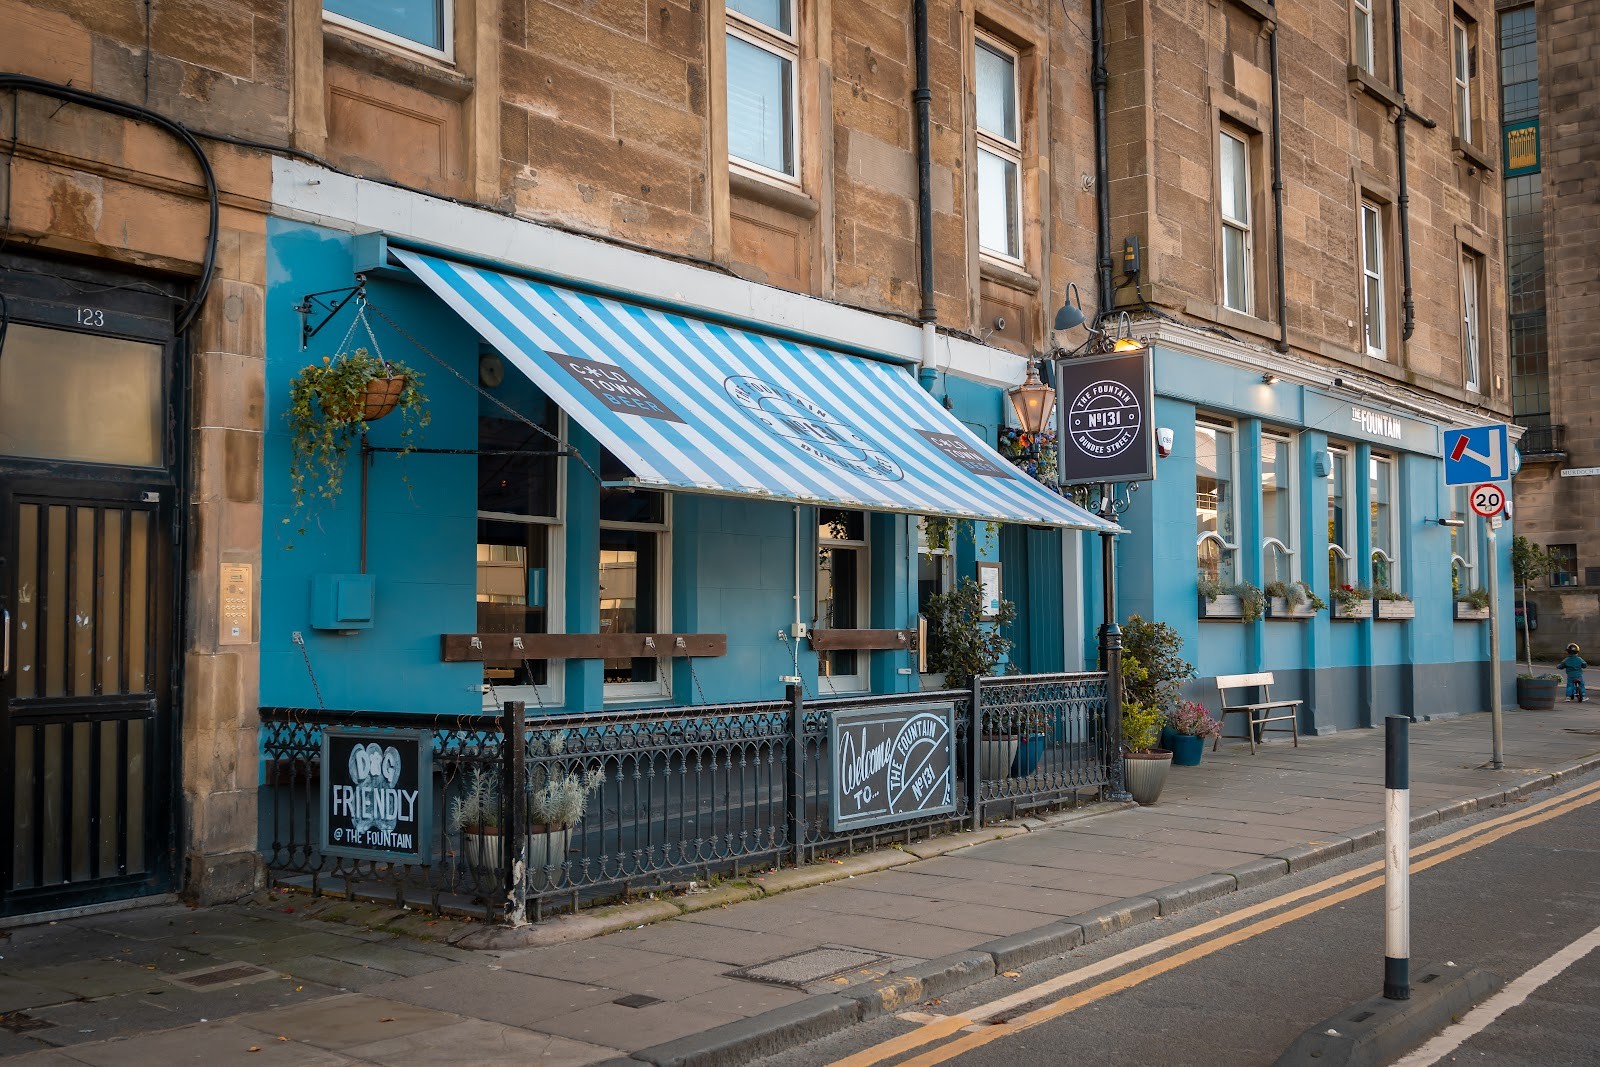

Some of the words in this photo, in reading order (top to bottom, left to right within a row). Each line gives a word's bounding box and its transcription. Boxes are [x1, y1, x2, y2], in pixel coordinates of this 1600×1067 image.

[77, 307, 104, 327] 123
[583, 377, 648, 398] TOWN
[1077, 392, 1092, 408] THE
[1092, 385, 1131, 403] FOUNTAIN
[602, 393, 664, 413] BEER
[743, 382, 826, 418] FOUNTAIN
[1351, 407, 1362, 420] THE
[1361, 410, 1402, 440] FOUNTAIN
[1078, 435, 1105, 454] DUNDEE
[1106, 431, 1132, 453] STREET
[943, 448, 985, 462] TOWN
[1476, 493, 1500, 507] 20
[839, 726, 892, 796] Welcome
[890, 759, 903, 791] THE
[897, 719, 937, 757] FOUNTAIN
[333, 784, 419, 822] FRIENDLY
[334, 827, 344, 841] @
[346, 828, 363, 844] THE
[366, 829, 412, 850] FOUNTAIN
